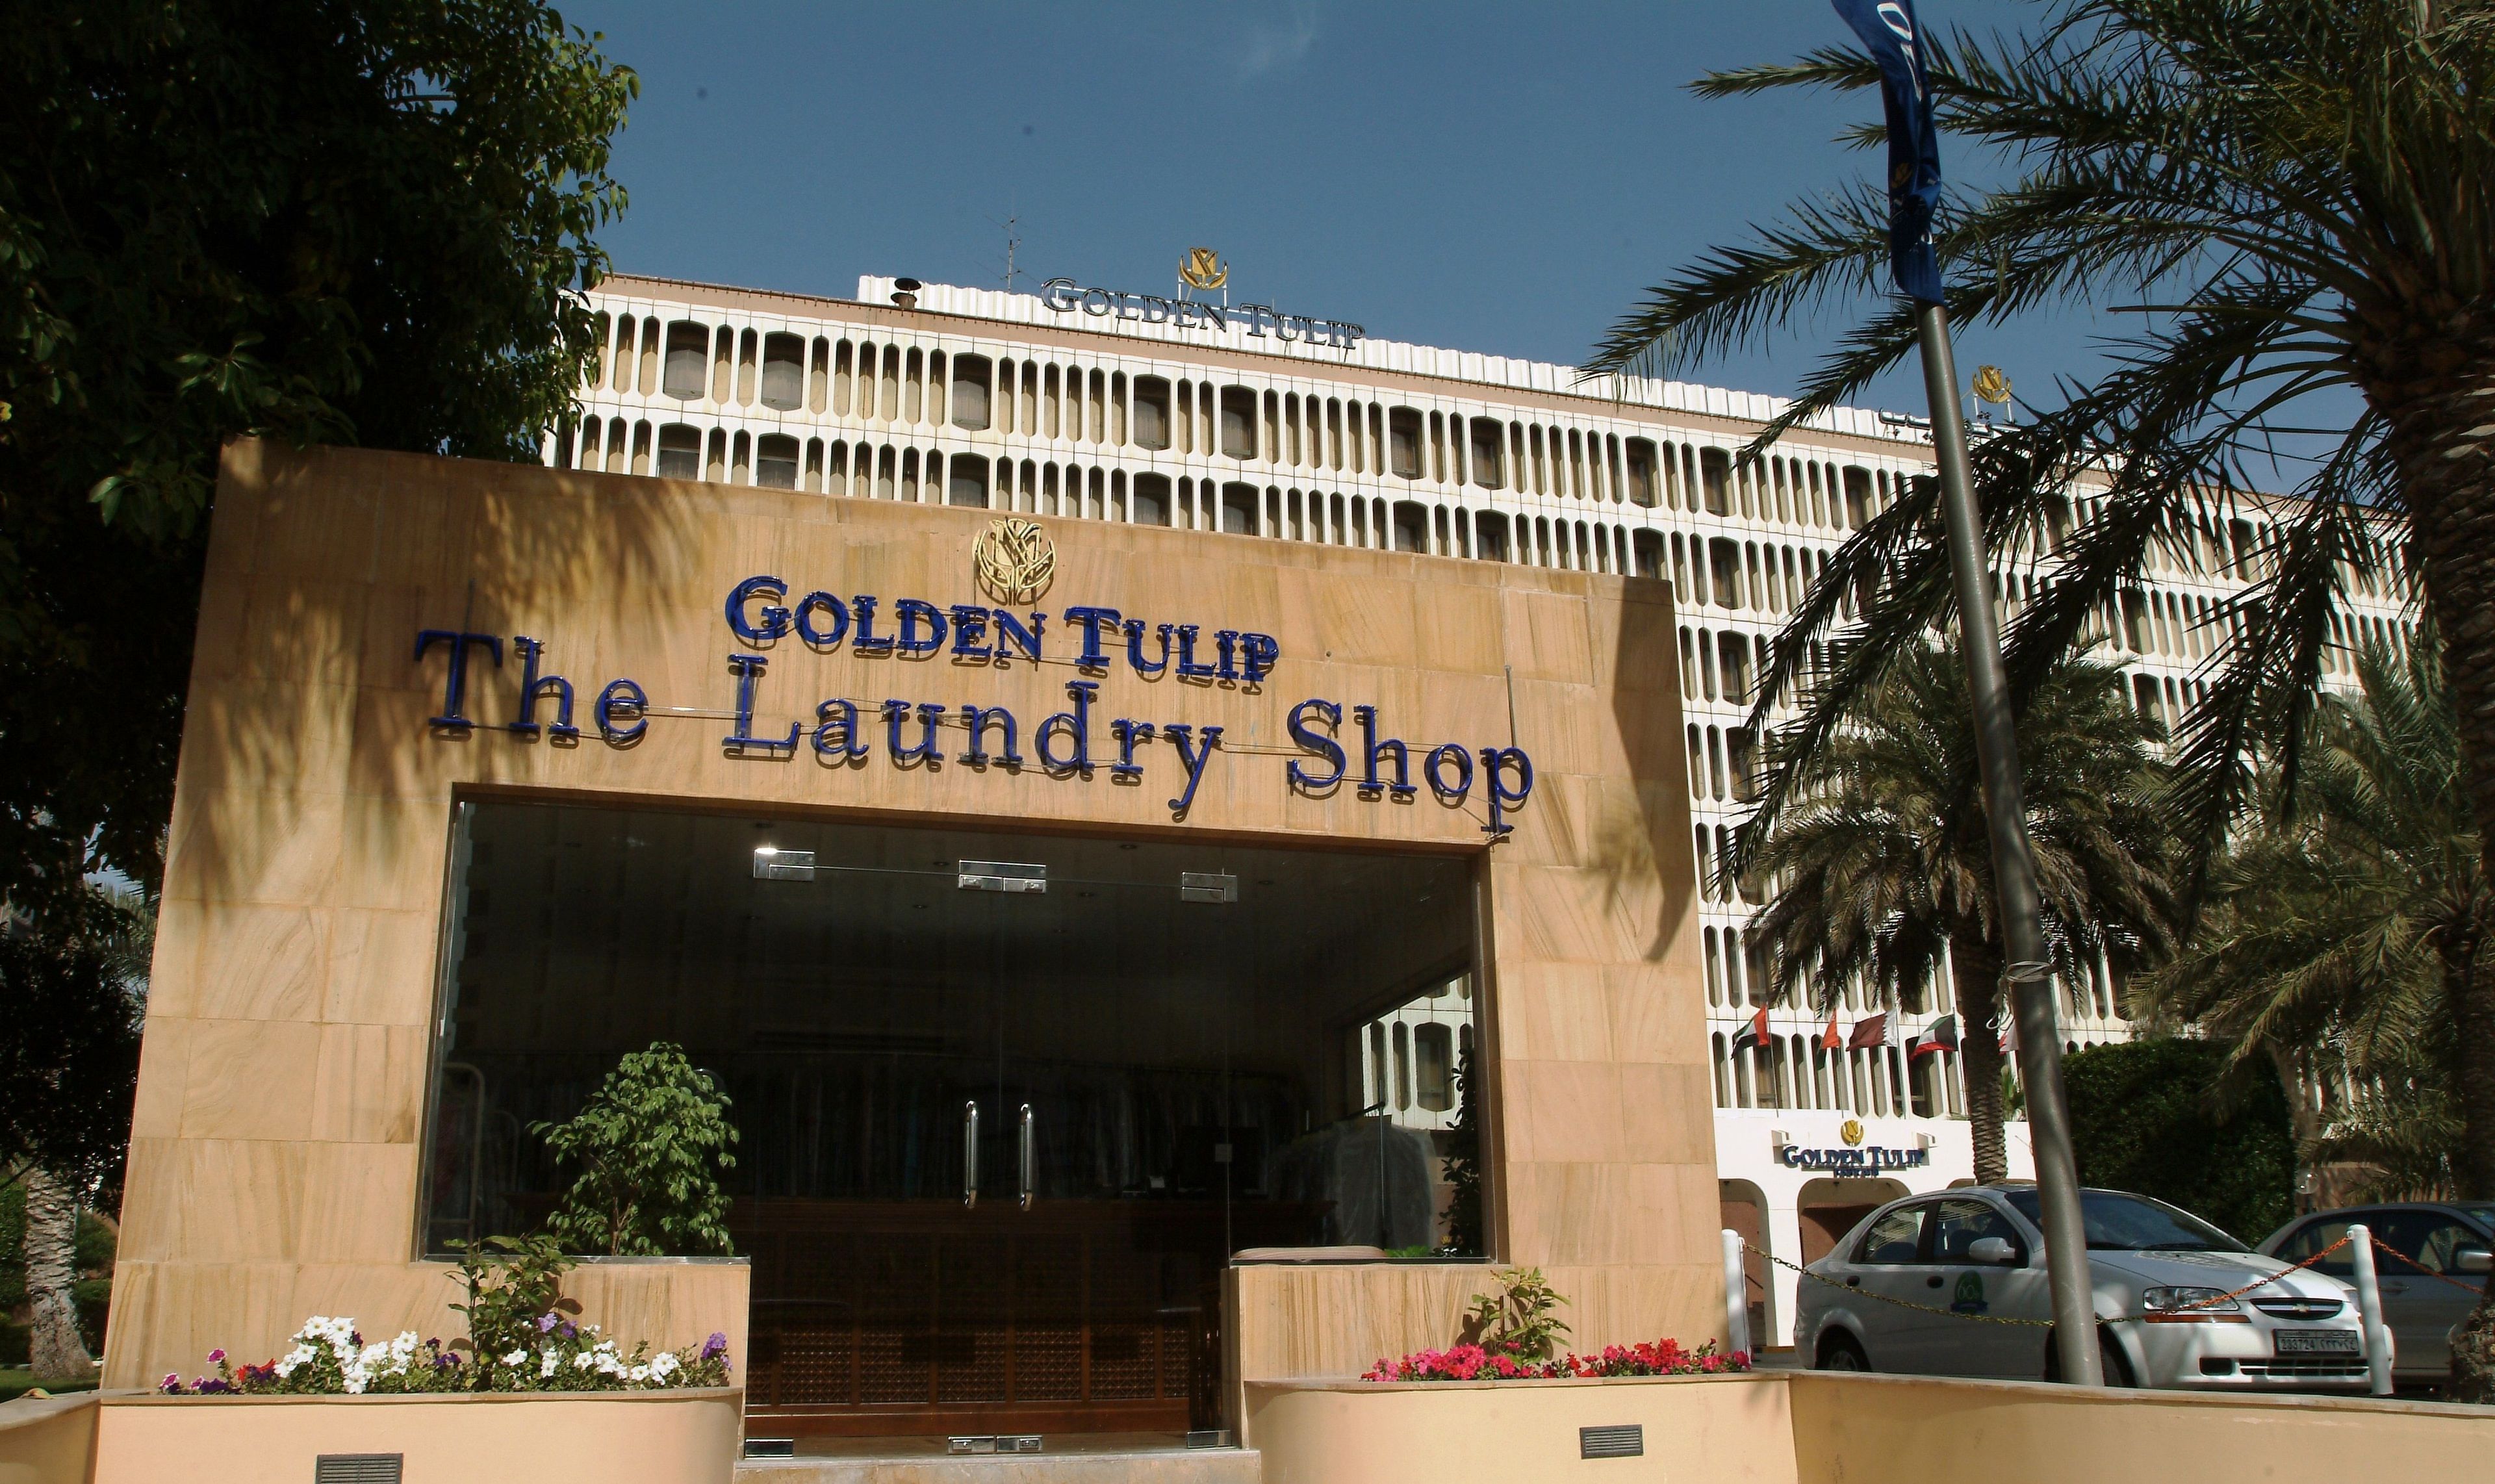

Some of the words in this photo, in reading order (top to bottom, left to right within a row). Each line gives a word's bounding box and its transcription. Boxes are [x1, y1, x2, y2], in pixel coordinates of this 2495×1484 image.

[1040, 277, 1228, 333] GOLDEN
[1240, 302, 1365, 350] TULIP
[725, 575, 1047, 663] GOLDEN
[1063, 606, 1279, 682] TULIP
[414, 629, 648, 736] The
[722, 653, 1225, 810] Laundry
[1286, 698, 1533, 834] Shop
[1783, 1145, 1864, 1166] GOLDEN
[1866, 1145, 1925, 1166] TULIP
